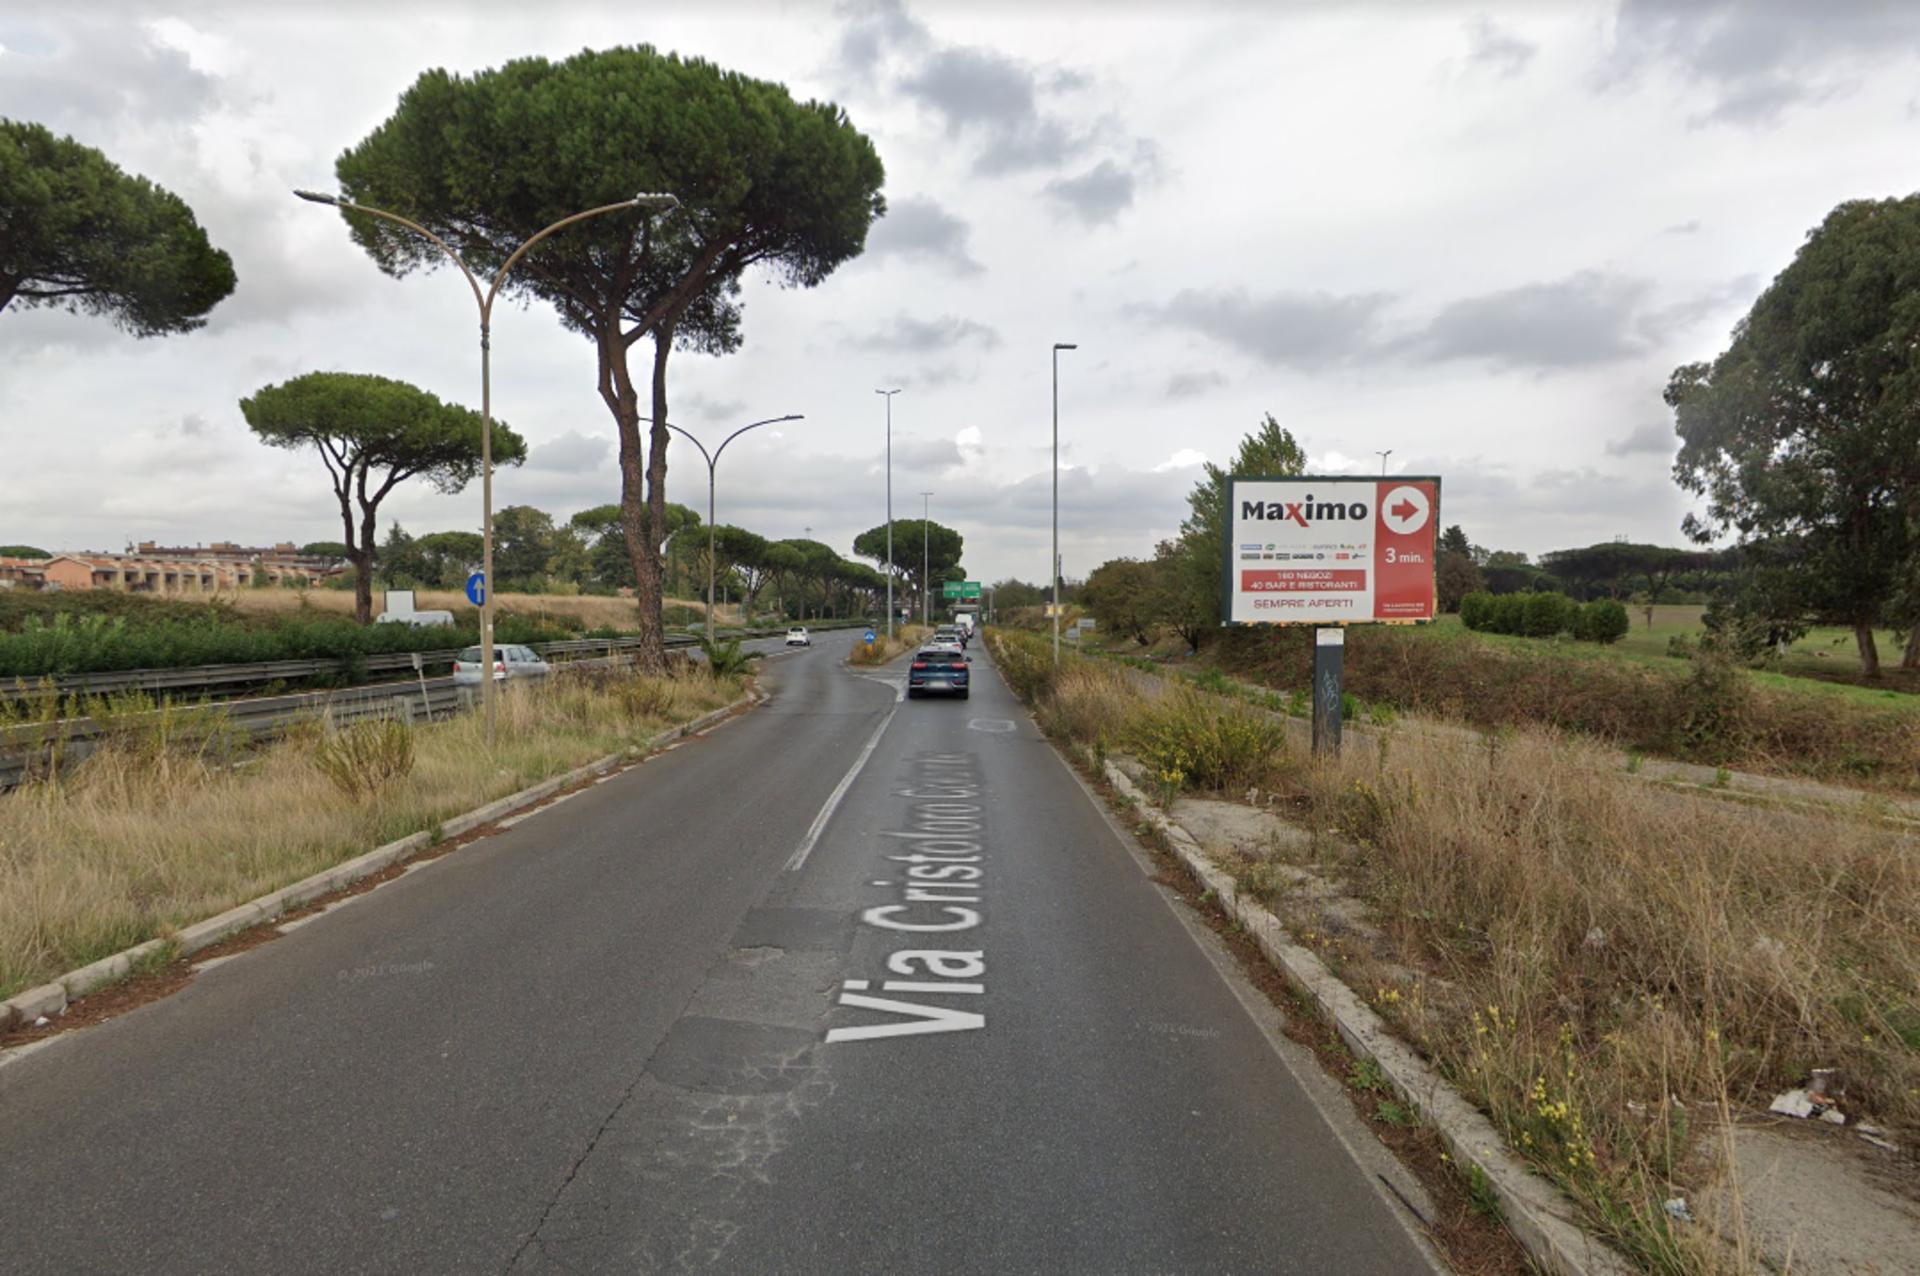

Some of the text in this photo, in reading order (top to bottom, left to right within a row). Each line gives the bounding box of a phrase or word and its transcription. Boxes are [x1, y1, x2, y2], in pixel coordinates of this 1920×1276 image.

[1242, 494, 1368, 527] Maximo
[1385, 547, 1424, 564] 3 min.
[1296, 571, 1333, 580] NEGOZI
[1250, 580, 1358, 590] 40 BAR E RISTORANTI
[1254, 598, 1353, 609] SEMPRE APERTI
